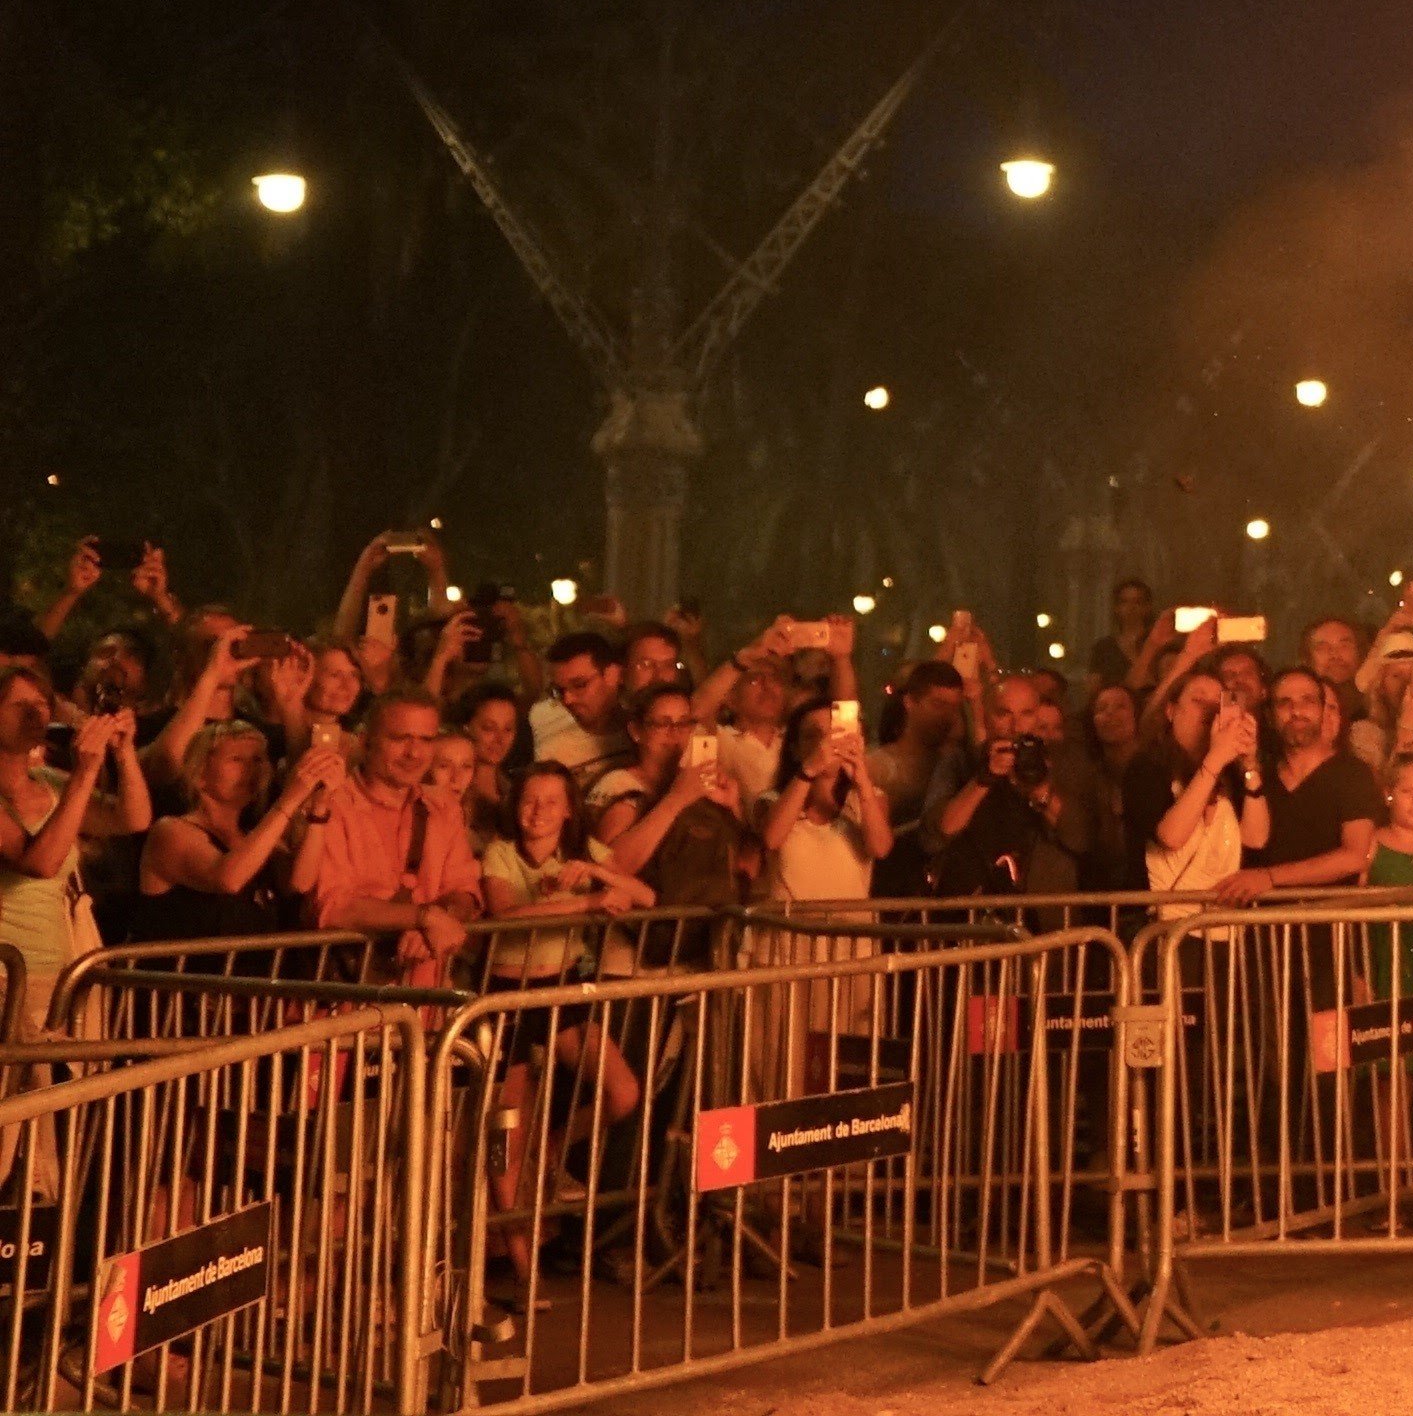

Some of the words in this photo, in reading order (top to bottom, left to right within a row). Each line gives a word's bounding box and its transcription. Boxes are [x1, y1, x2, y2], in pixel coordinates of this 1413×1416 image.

[1351, 1027, 1393, 1045] Ajuntamen
[768, 1124, 832, 1153] Ajuntament
[835, 1120, 849, 1137] de
[850, 1113, 905, 1136] Barcelona
[143, 1265, 205, 1315] Ajuntament
[205, 1261, 217, 1285] de
[217, 1246, 264, 1280] Barcelona
